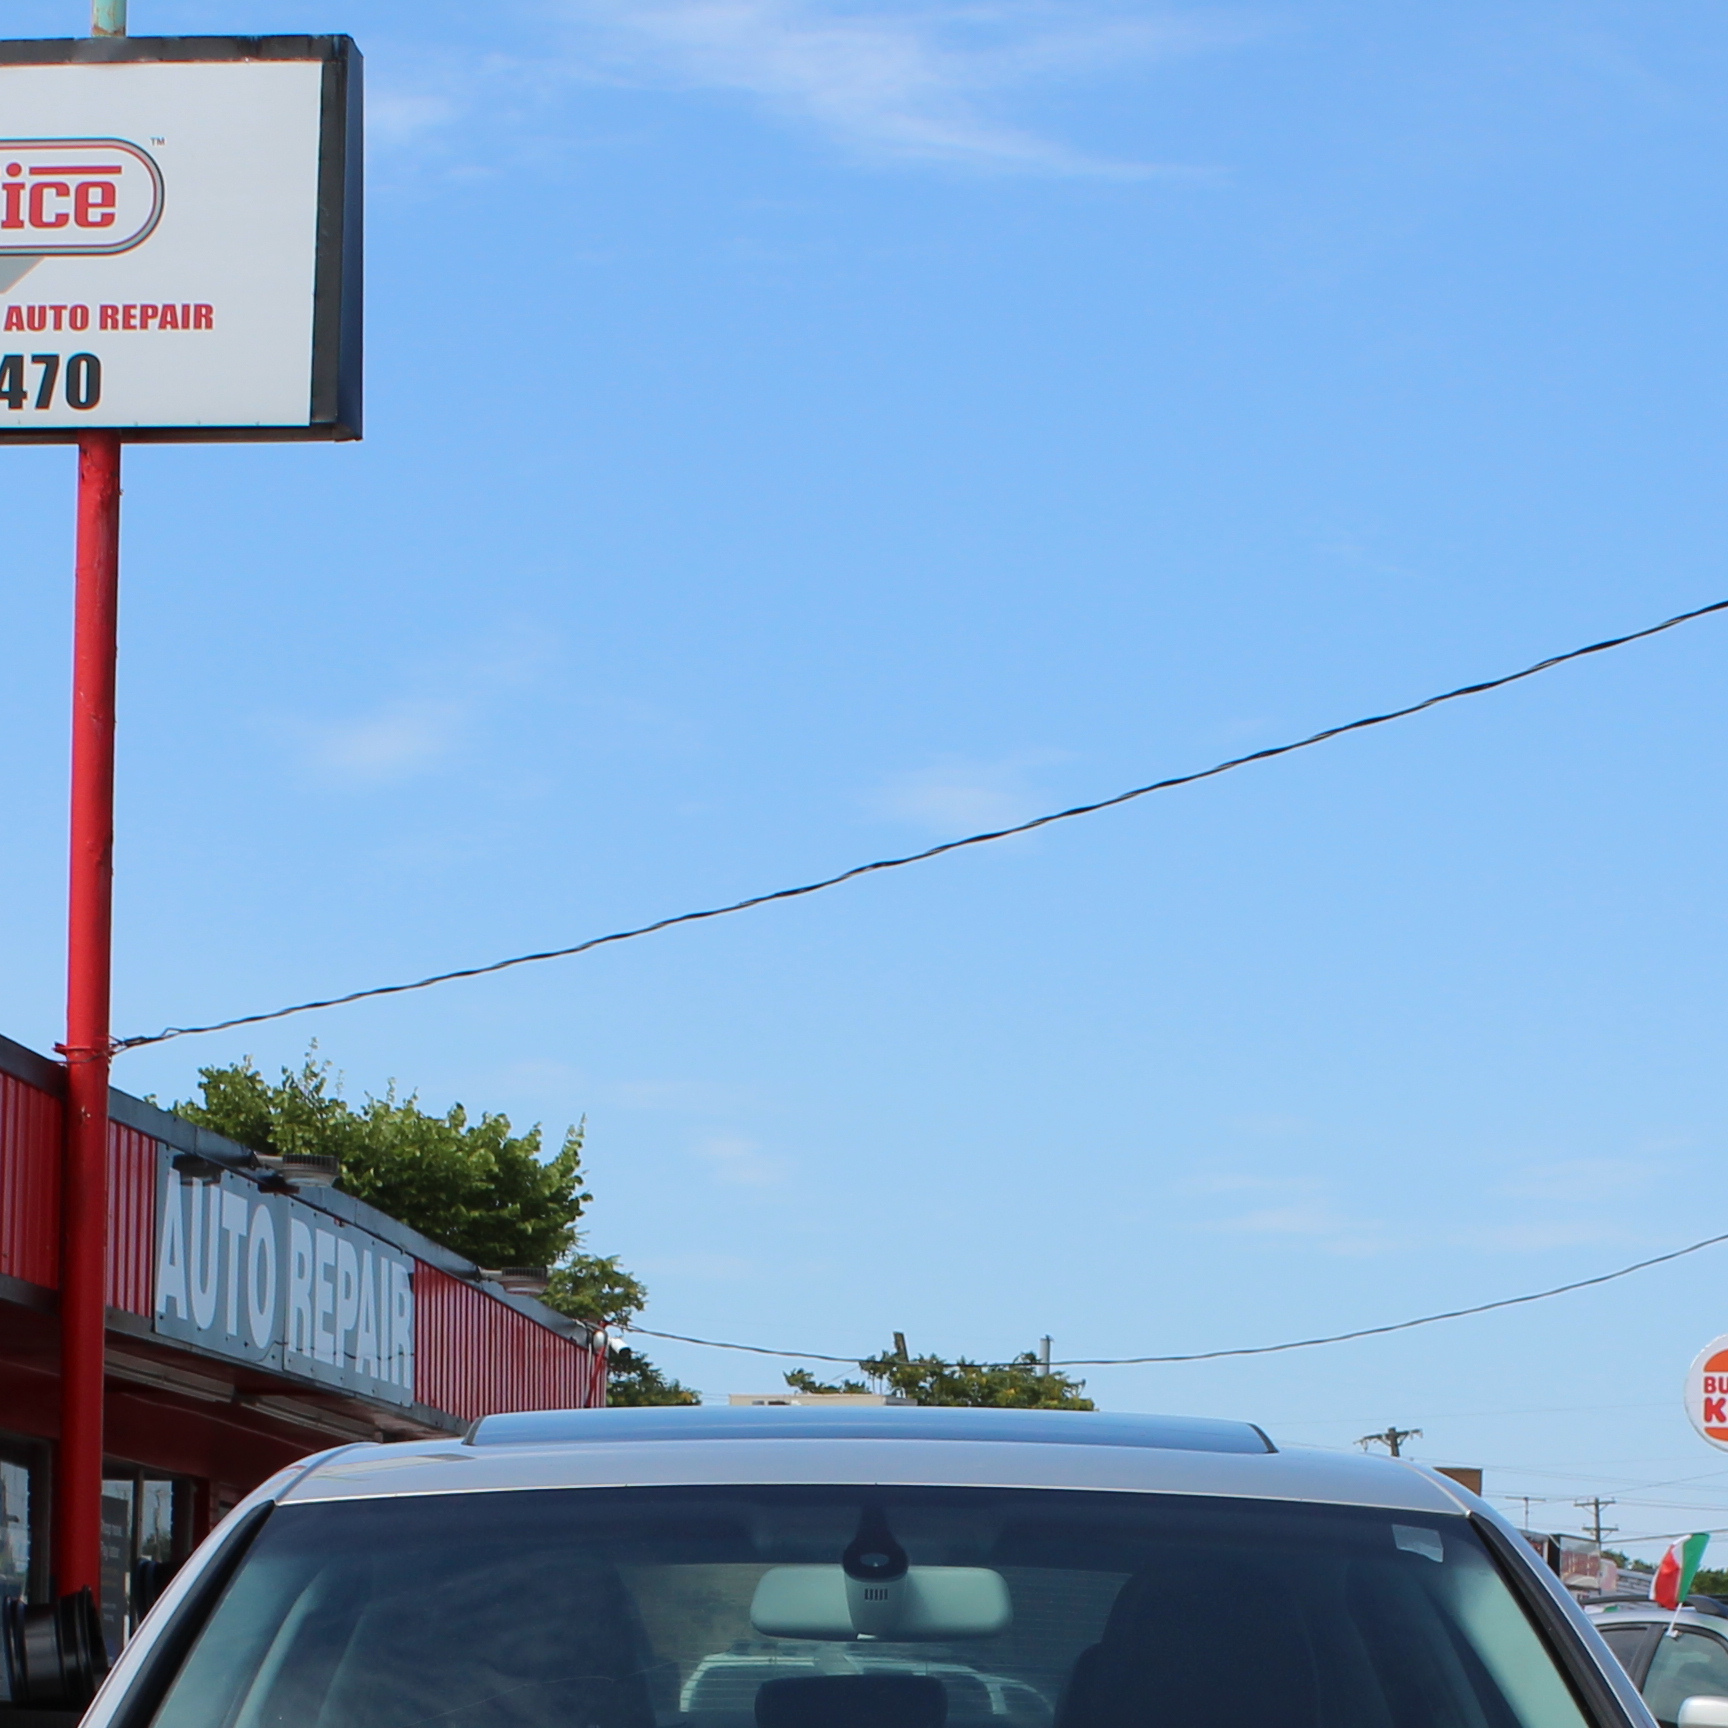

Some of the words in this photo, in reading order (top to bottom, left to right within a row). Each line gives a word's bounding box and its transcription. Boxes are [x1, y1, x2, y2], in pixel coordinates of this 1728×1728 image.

[3, 303, 90, 332] AUTO
[99, 302, 215, 331] REPAIR
[155, 1168, 277, 1350] AUTO
[288, 1217, 414, 1390] REPAIR
